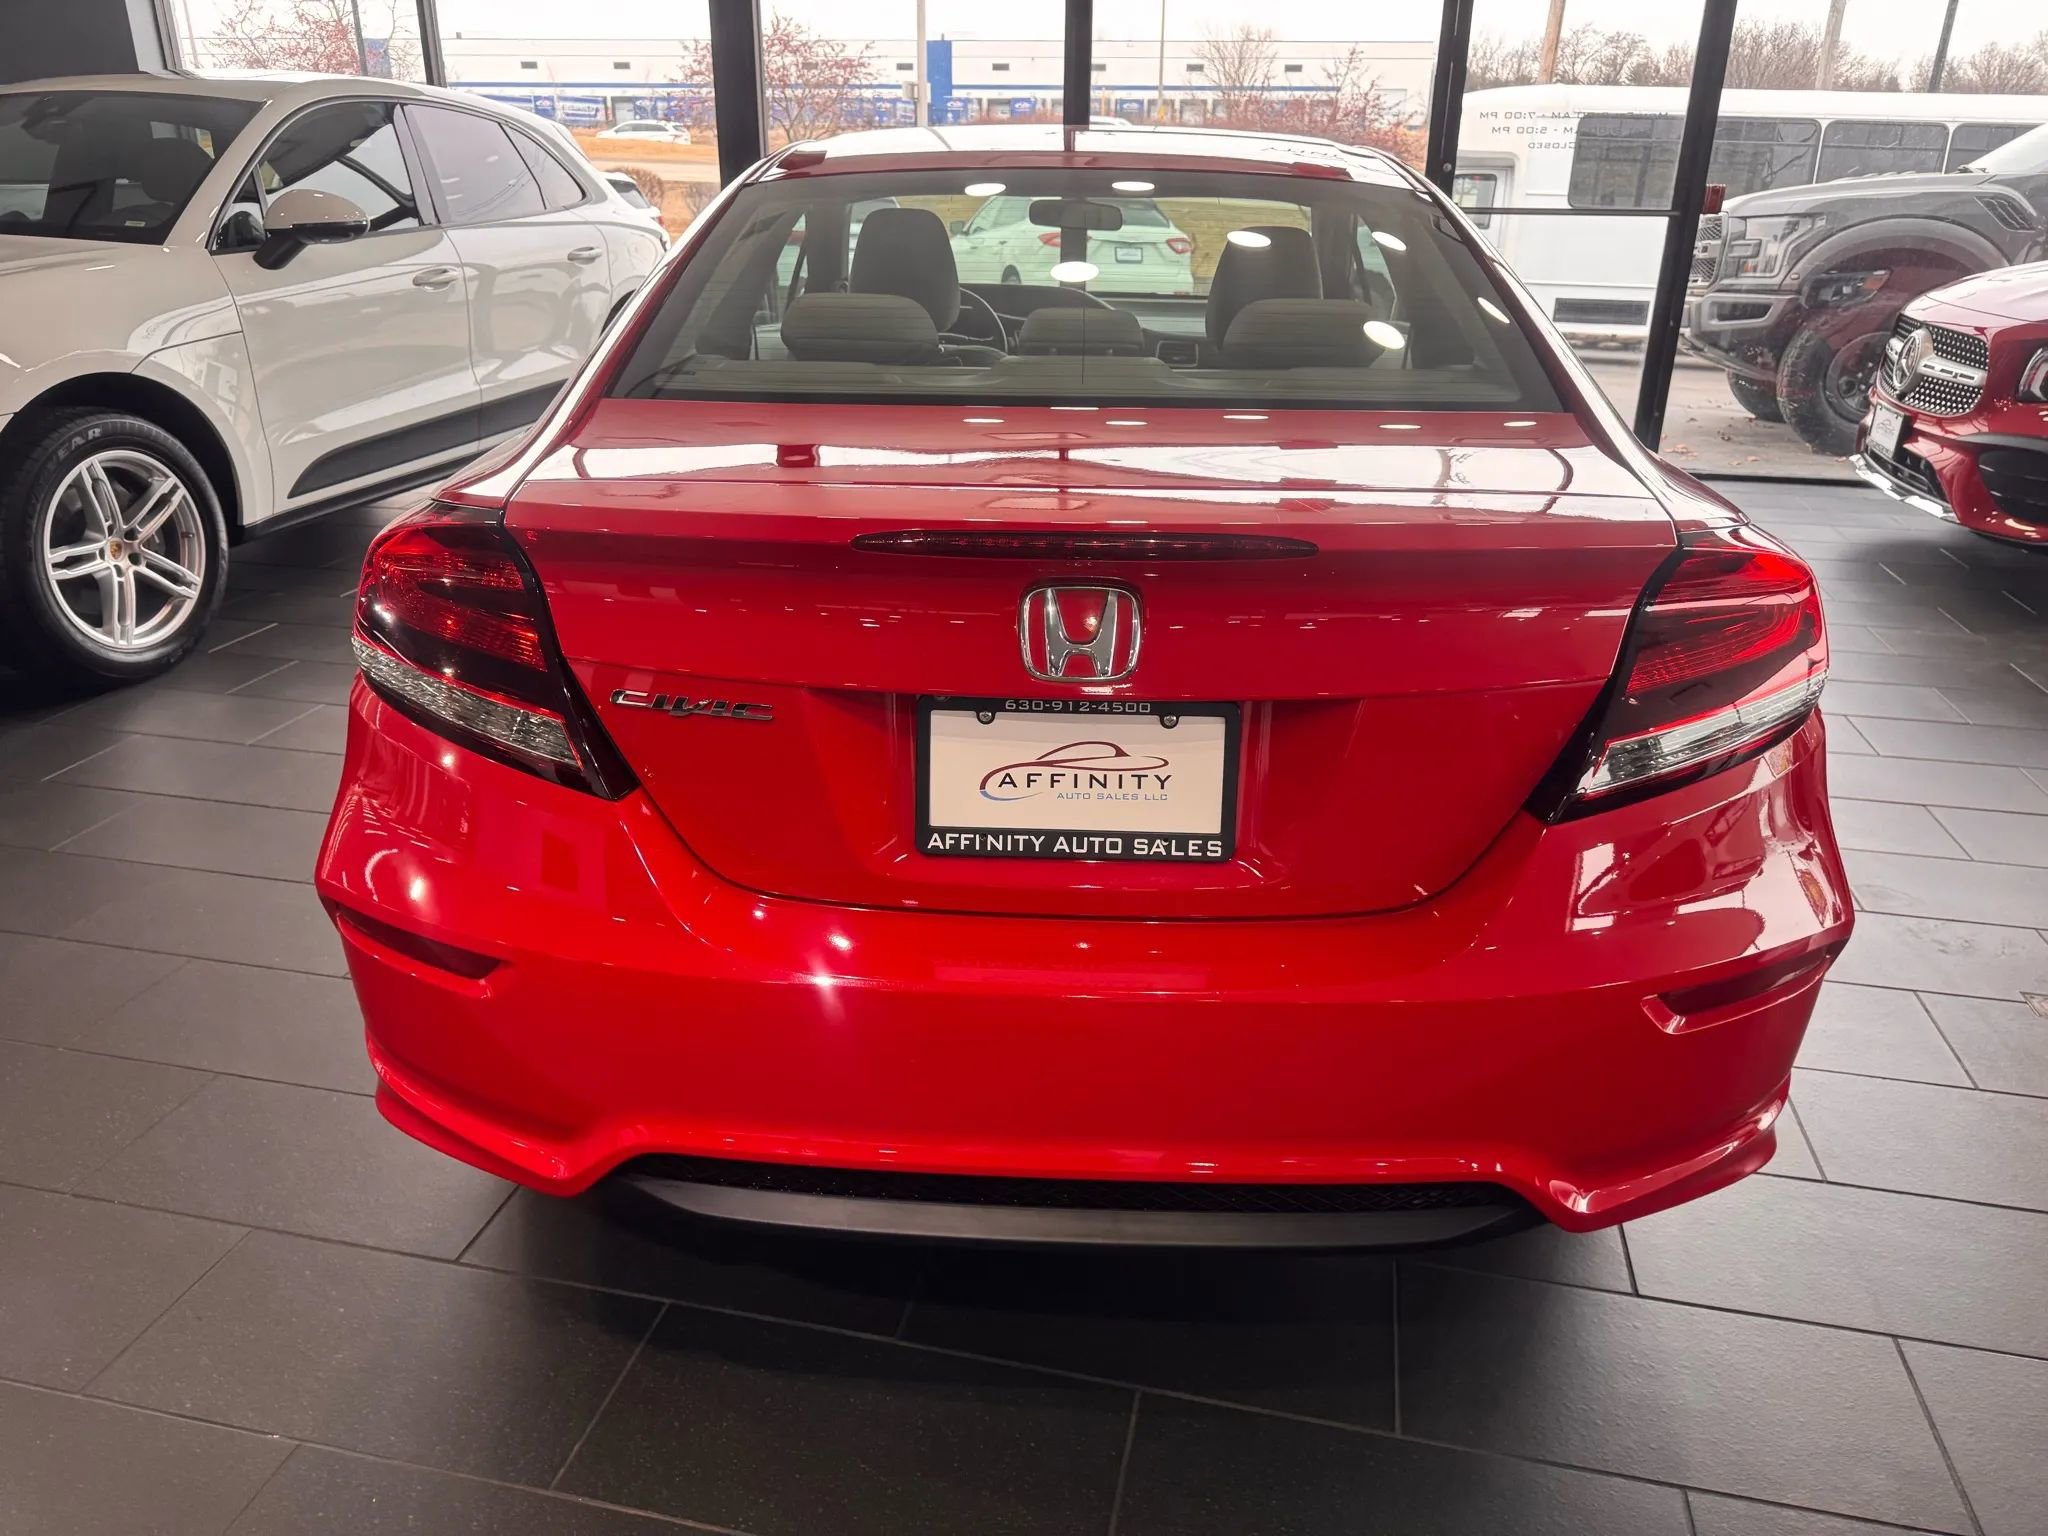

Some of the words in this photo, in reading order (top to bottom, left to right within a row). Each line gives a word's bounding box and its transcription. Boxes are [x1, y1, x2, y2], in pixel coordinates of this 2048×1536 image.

[609, 688, 774, 721] CIVIC
[1005, 699, 1151, 713] 630-912-4500
[998, 772, 1173, 790] AFFINITY
[1056, 792, 1091, 800] AUTO
[1096, 792, 1139, 801] SALES
[1144, 793, 1168, 801] LLC
[927, 832, 1046, 852] AFFINITY
[1053, 836, 1122, 854] AUTO
[1133, 838, 1222, 857] SALES
